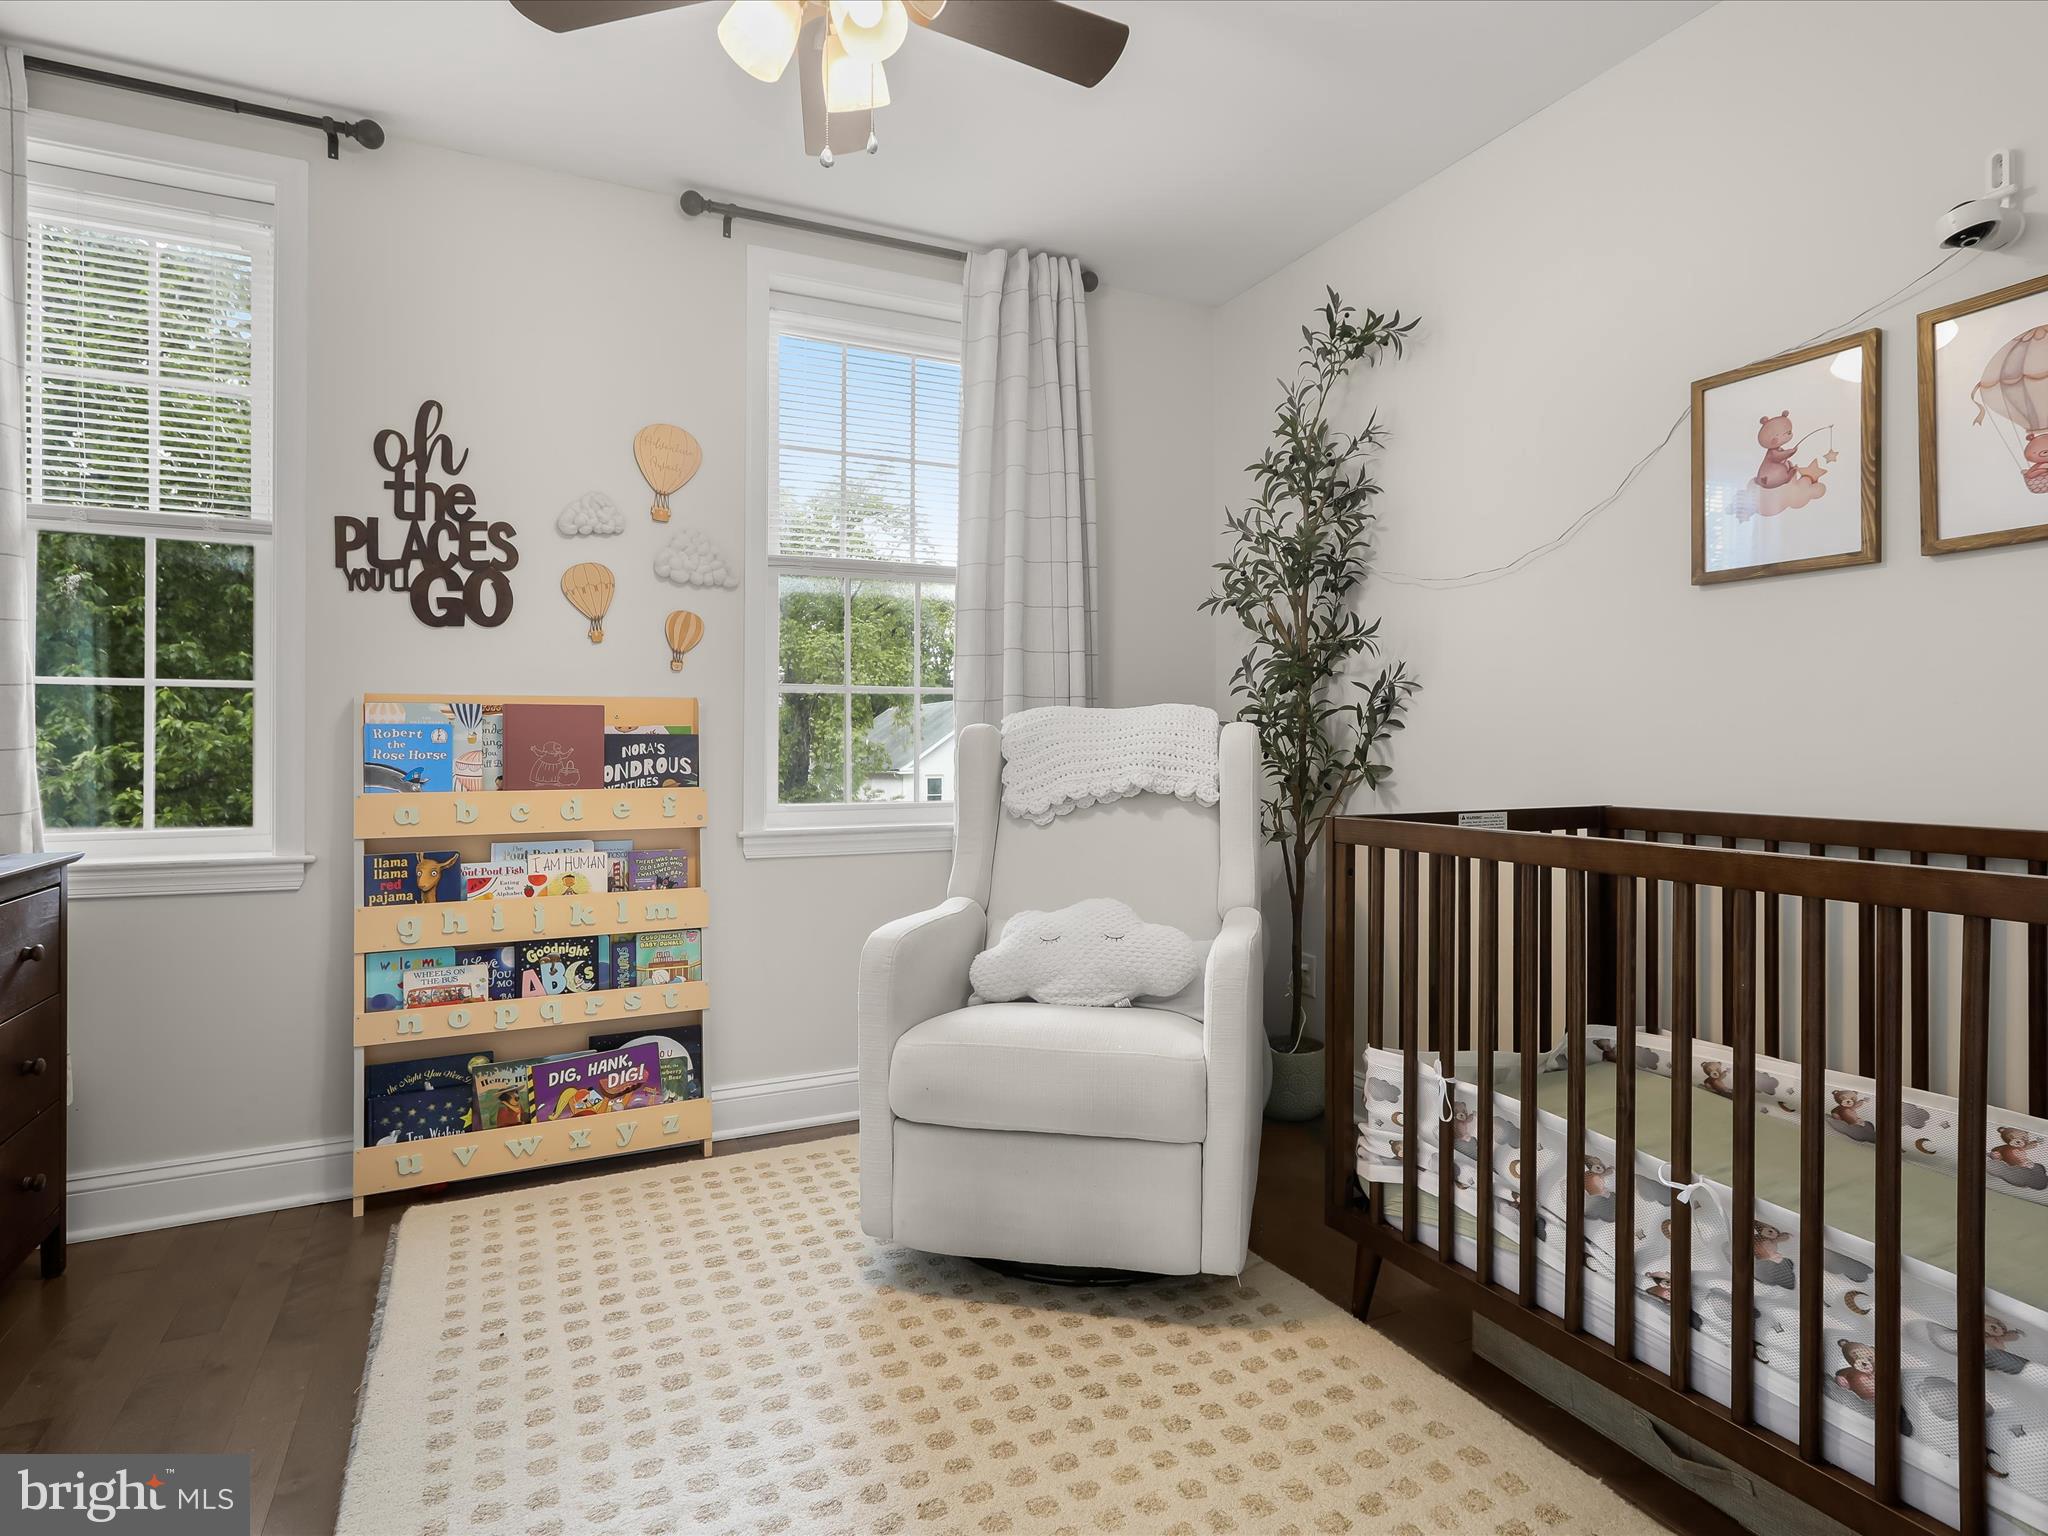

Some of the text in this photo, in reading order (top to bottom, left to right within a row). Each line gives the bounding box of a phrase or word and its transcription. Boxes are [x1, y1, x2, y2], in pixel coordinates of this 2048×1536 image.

[373, 399, 469, 476] oh
[384, 467, 476, 521] the
[334, 515, 520, 572] PLACES
[410, 569, 514, 628] GO
[372, 728, 424, 740] Robert
[387, 740, 406, 749] the
[621, 742, 665, 758] NORA'S
[372, 749, 447, 760] Rose Horse
[604, 756, 692, 783] ONDROUS
[454, 800, 479, 824] b
[561, 799, 583, 821] d
[663, 795, 677, 818] f
[373, 858, 408, 868] llama
[506, 865, 525, 875] Fish
[532, 855, 606, 873] I AM HUMAN
[373, 869, 408, 880] llama
[380, 880, 402, 890] red
[368, 891, 414, 907] pajama
[397, 914, 421, 944] g
[441, 910, 469, 934] h
[569, 902, 596, 926] k
[645, 900, 677, 920] m
[526, 942, 590, 963] Goodnight
[413, 970, 452, 979] WHEELS
[420, 975, 459, 985] THE BUS
[495, 1003, 518, 1030] p
[662, 988, 680, 1009] t
[548, 1054, 633, 1088] DIG, HANK,
[607, 1064, 645, 1088] DIG!
[480, 1078, 510, 1087] Henry
